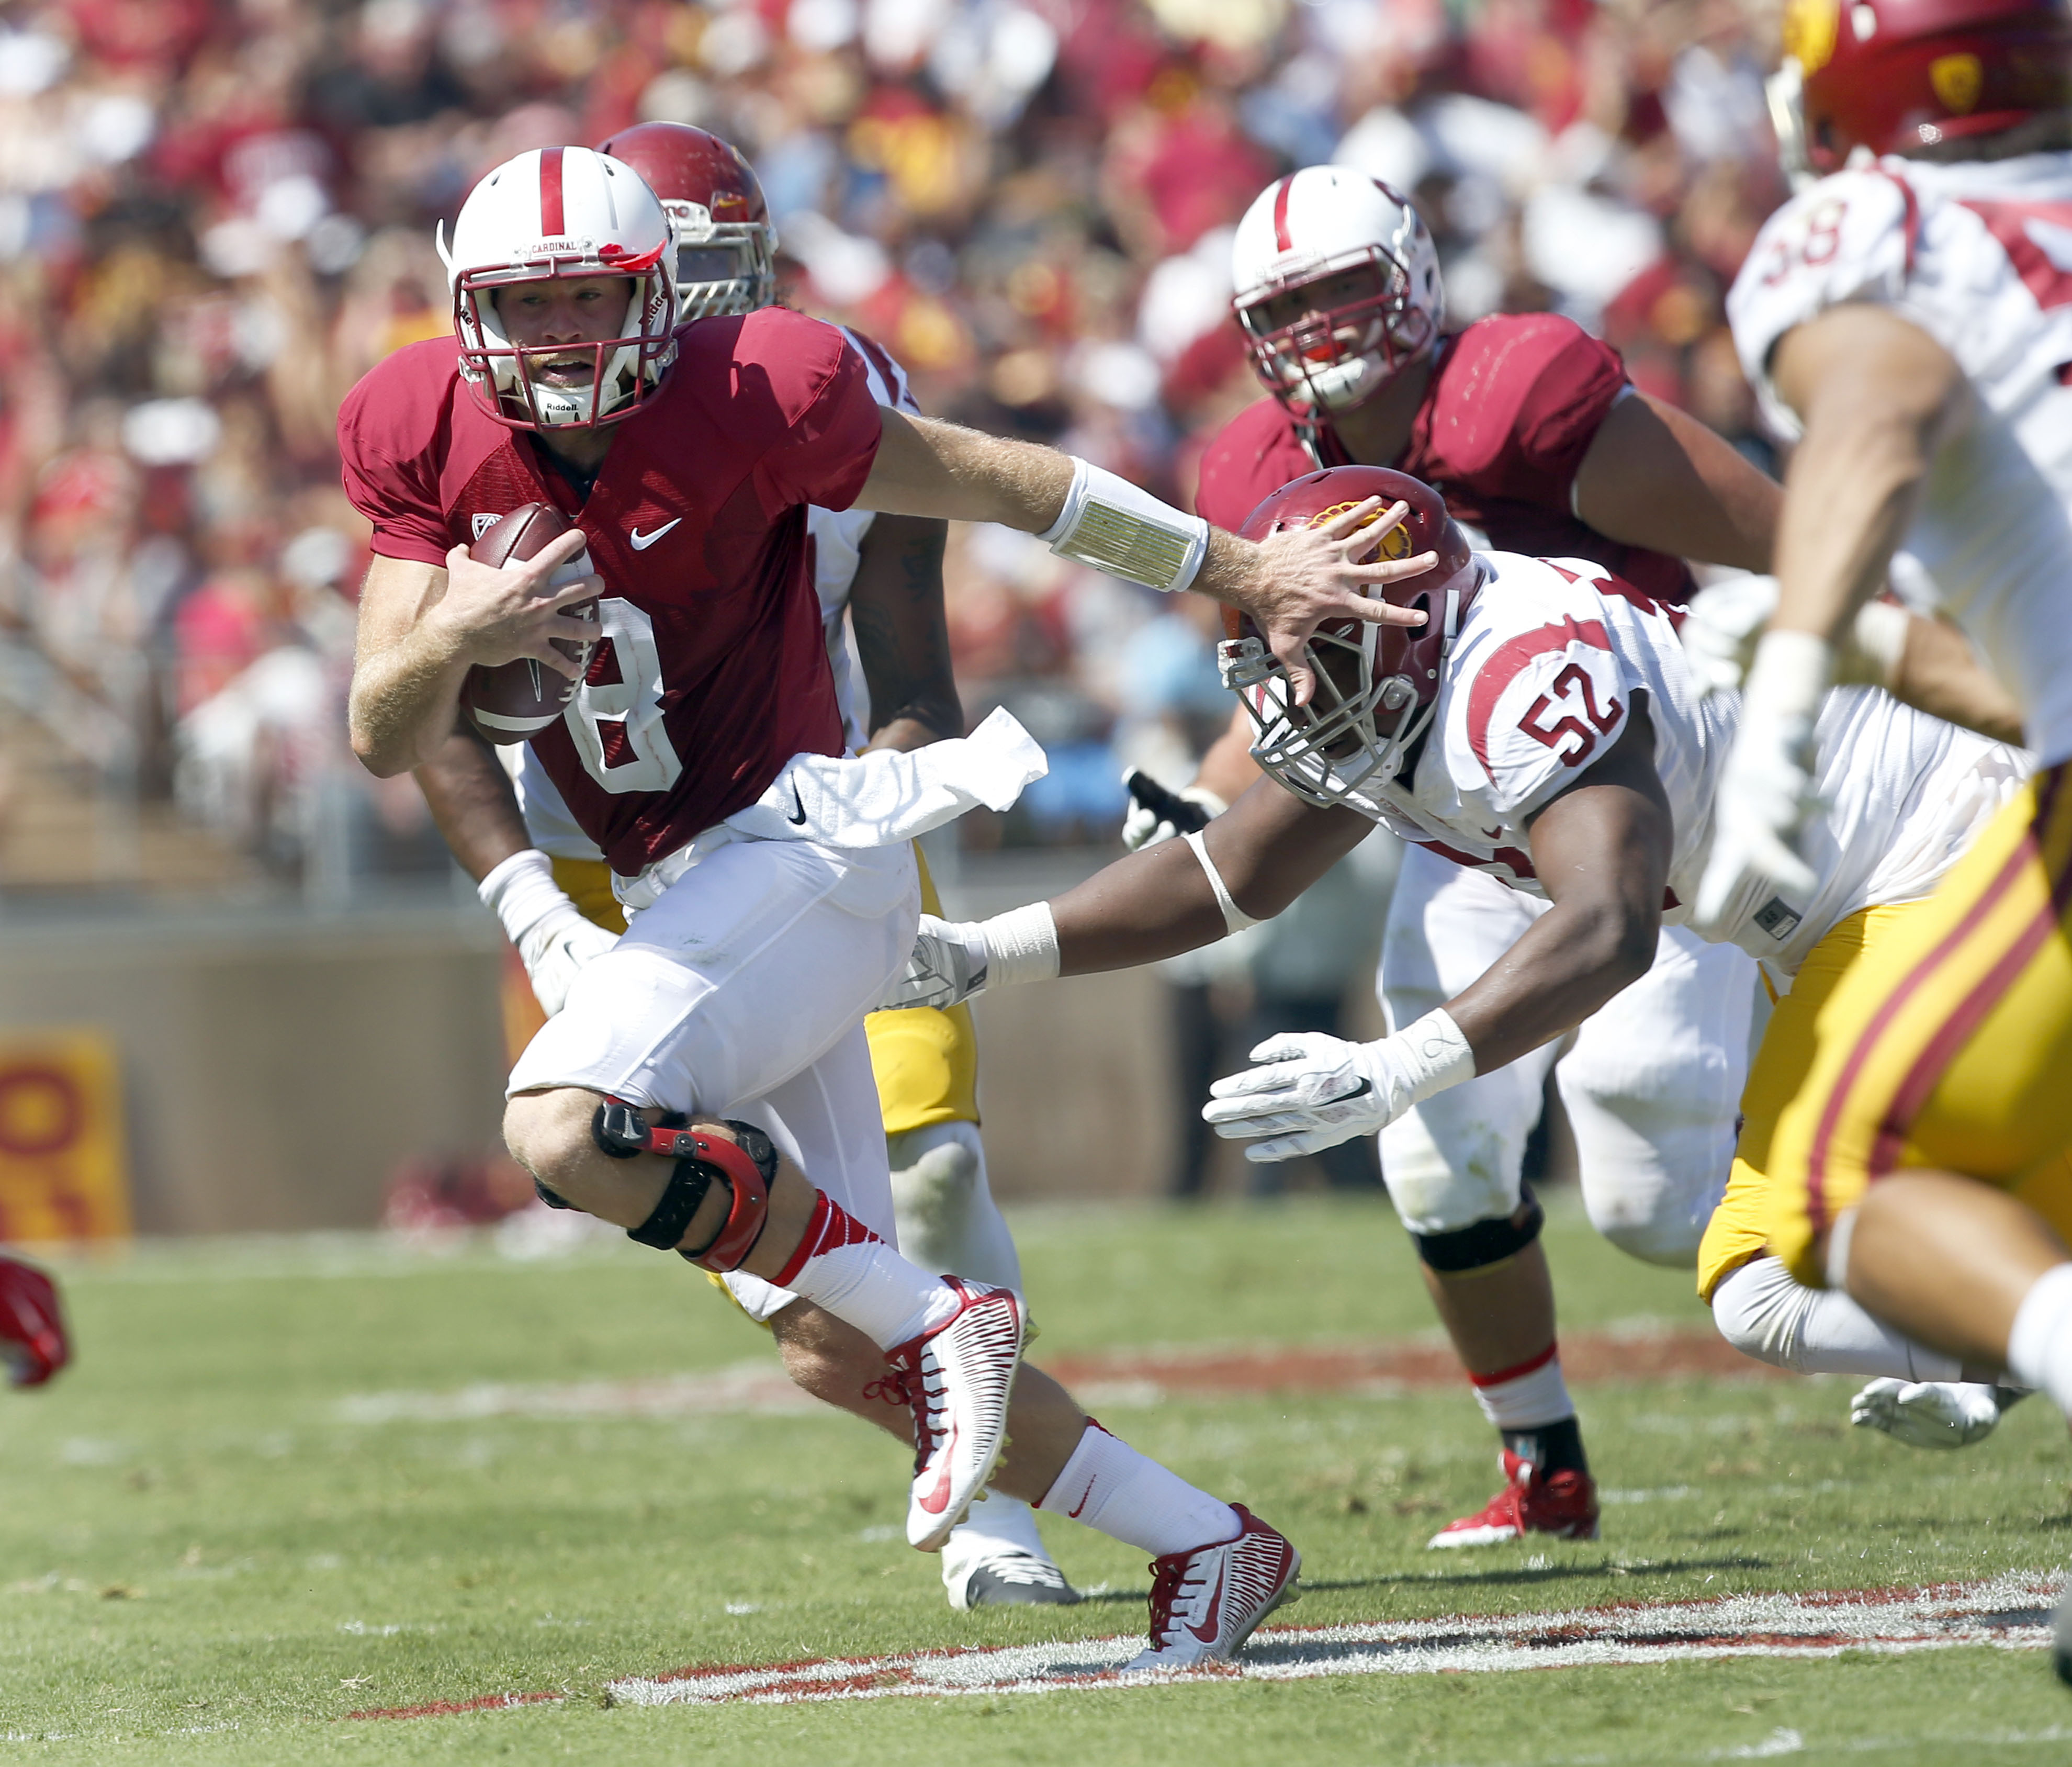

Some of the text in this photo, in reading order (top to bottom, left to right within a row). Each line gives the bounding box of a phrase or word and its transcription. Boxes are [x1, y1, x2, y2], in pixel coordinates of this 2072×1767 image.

[532, 242, 577, 253] CARDINAL
[563, 597, 683, 794] 8
[1516, 663, 1625, 768] 52
